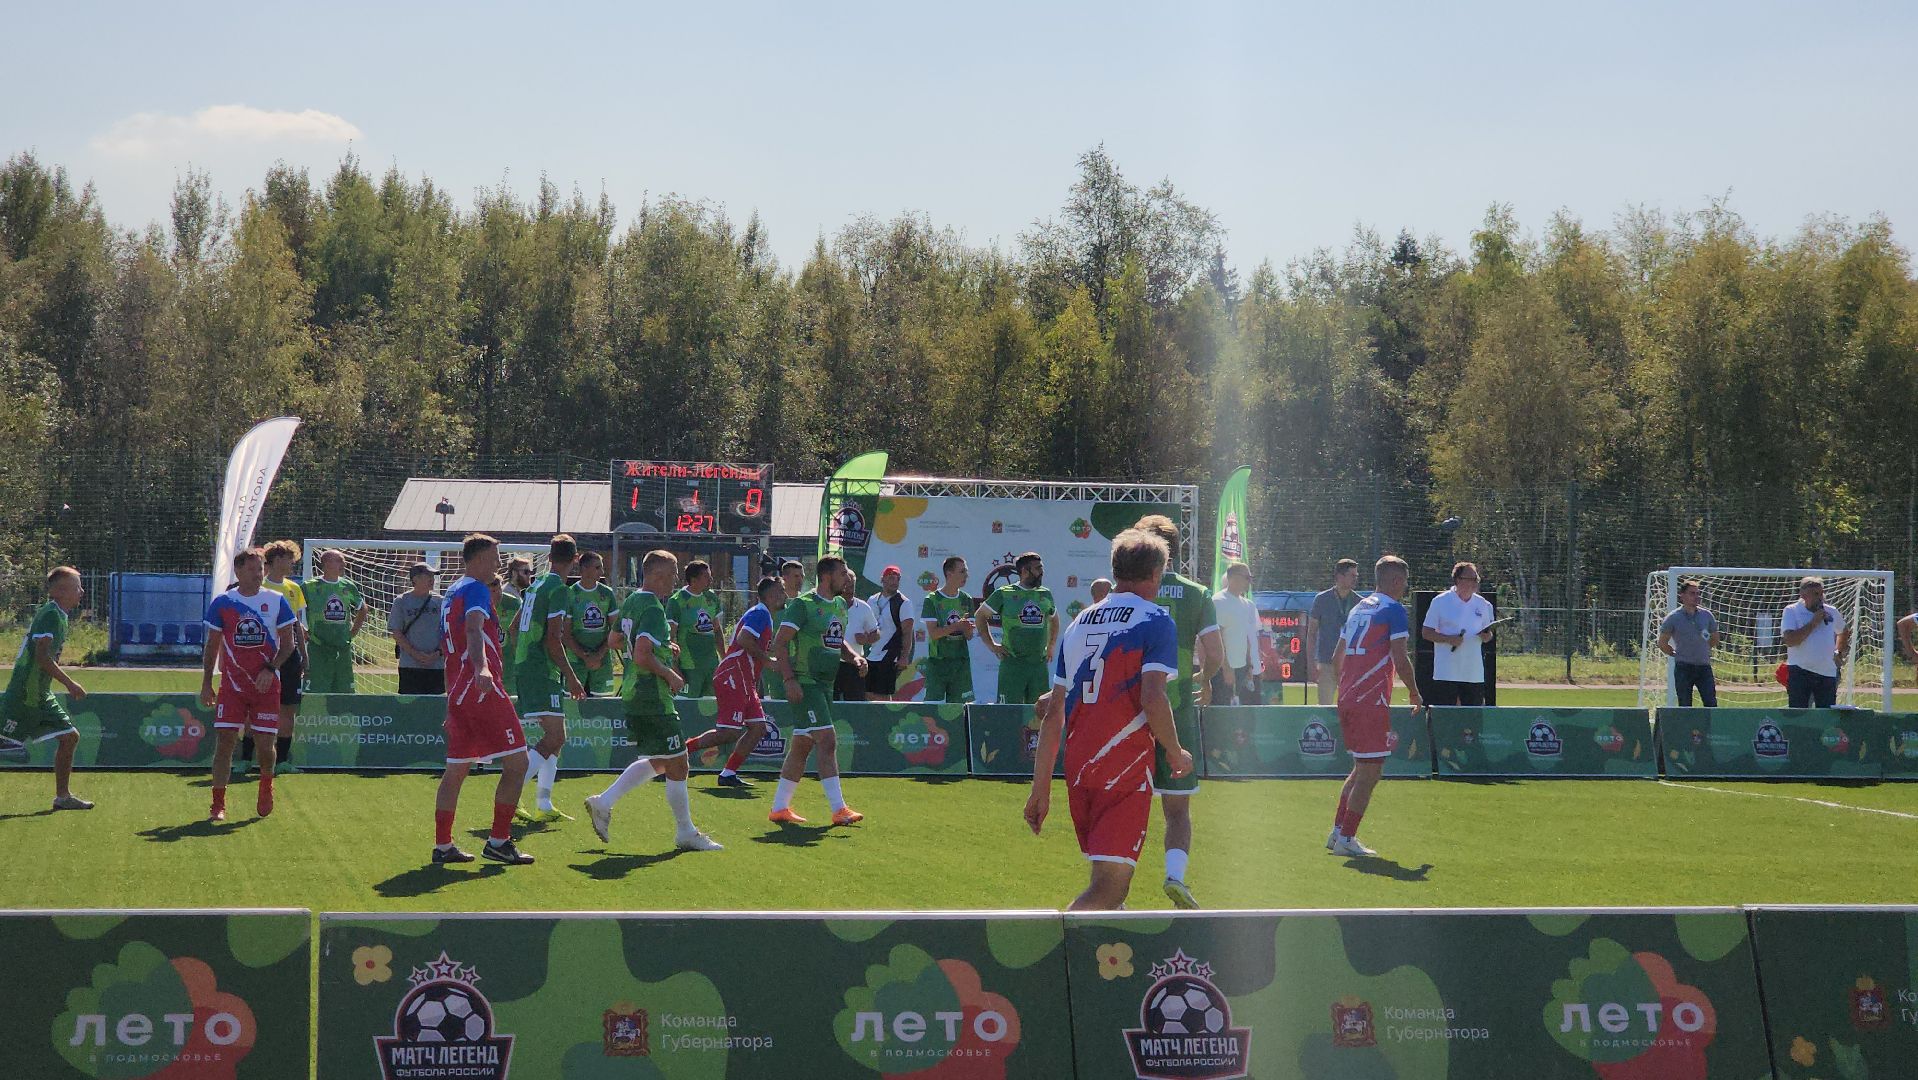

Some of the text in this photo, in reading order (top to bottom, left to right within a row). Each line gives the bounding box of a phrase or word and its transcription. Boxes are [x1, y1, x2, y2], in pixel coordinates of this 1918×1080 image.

[745, 488, 763, 514] 0
[1156, 584, 1184, 598] ИРОВ
[1082, 632, 1109, 704] 3
[295, 715, 393, 727] ОДИВОДВОР
[807, 710, 817, 724] 9
[295, 733, 445, 745] АНДАГУБЕРНАТОРА
[505, 728, 515, 745] 5
[661, 1013, 737, 1029] Команда
[1384, 1006, 1455, 1021] Команда
[1560, 1002, 1705, 1033] лето
[69, 1012, 242, 1046] лето
[850, 1011, 1008, 1042] лето
[1386, 1025, 1489, 1043] Губернатора
[662, 1034, 773, 1052] Губернатора
[1140, 1037, 1240, 1056] МАТЧ ЛЕГЕНД
[391, 1046, 499, 1065] МАТЧ ЛЕГЕНД
[1145, 1057, 1236, 1067] ФУТБОЛА РОССИИ
[396, 1067, 495, 1077] ФУТБОЛА РОССИИ
